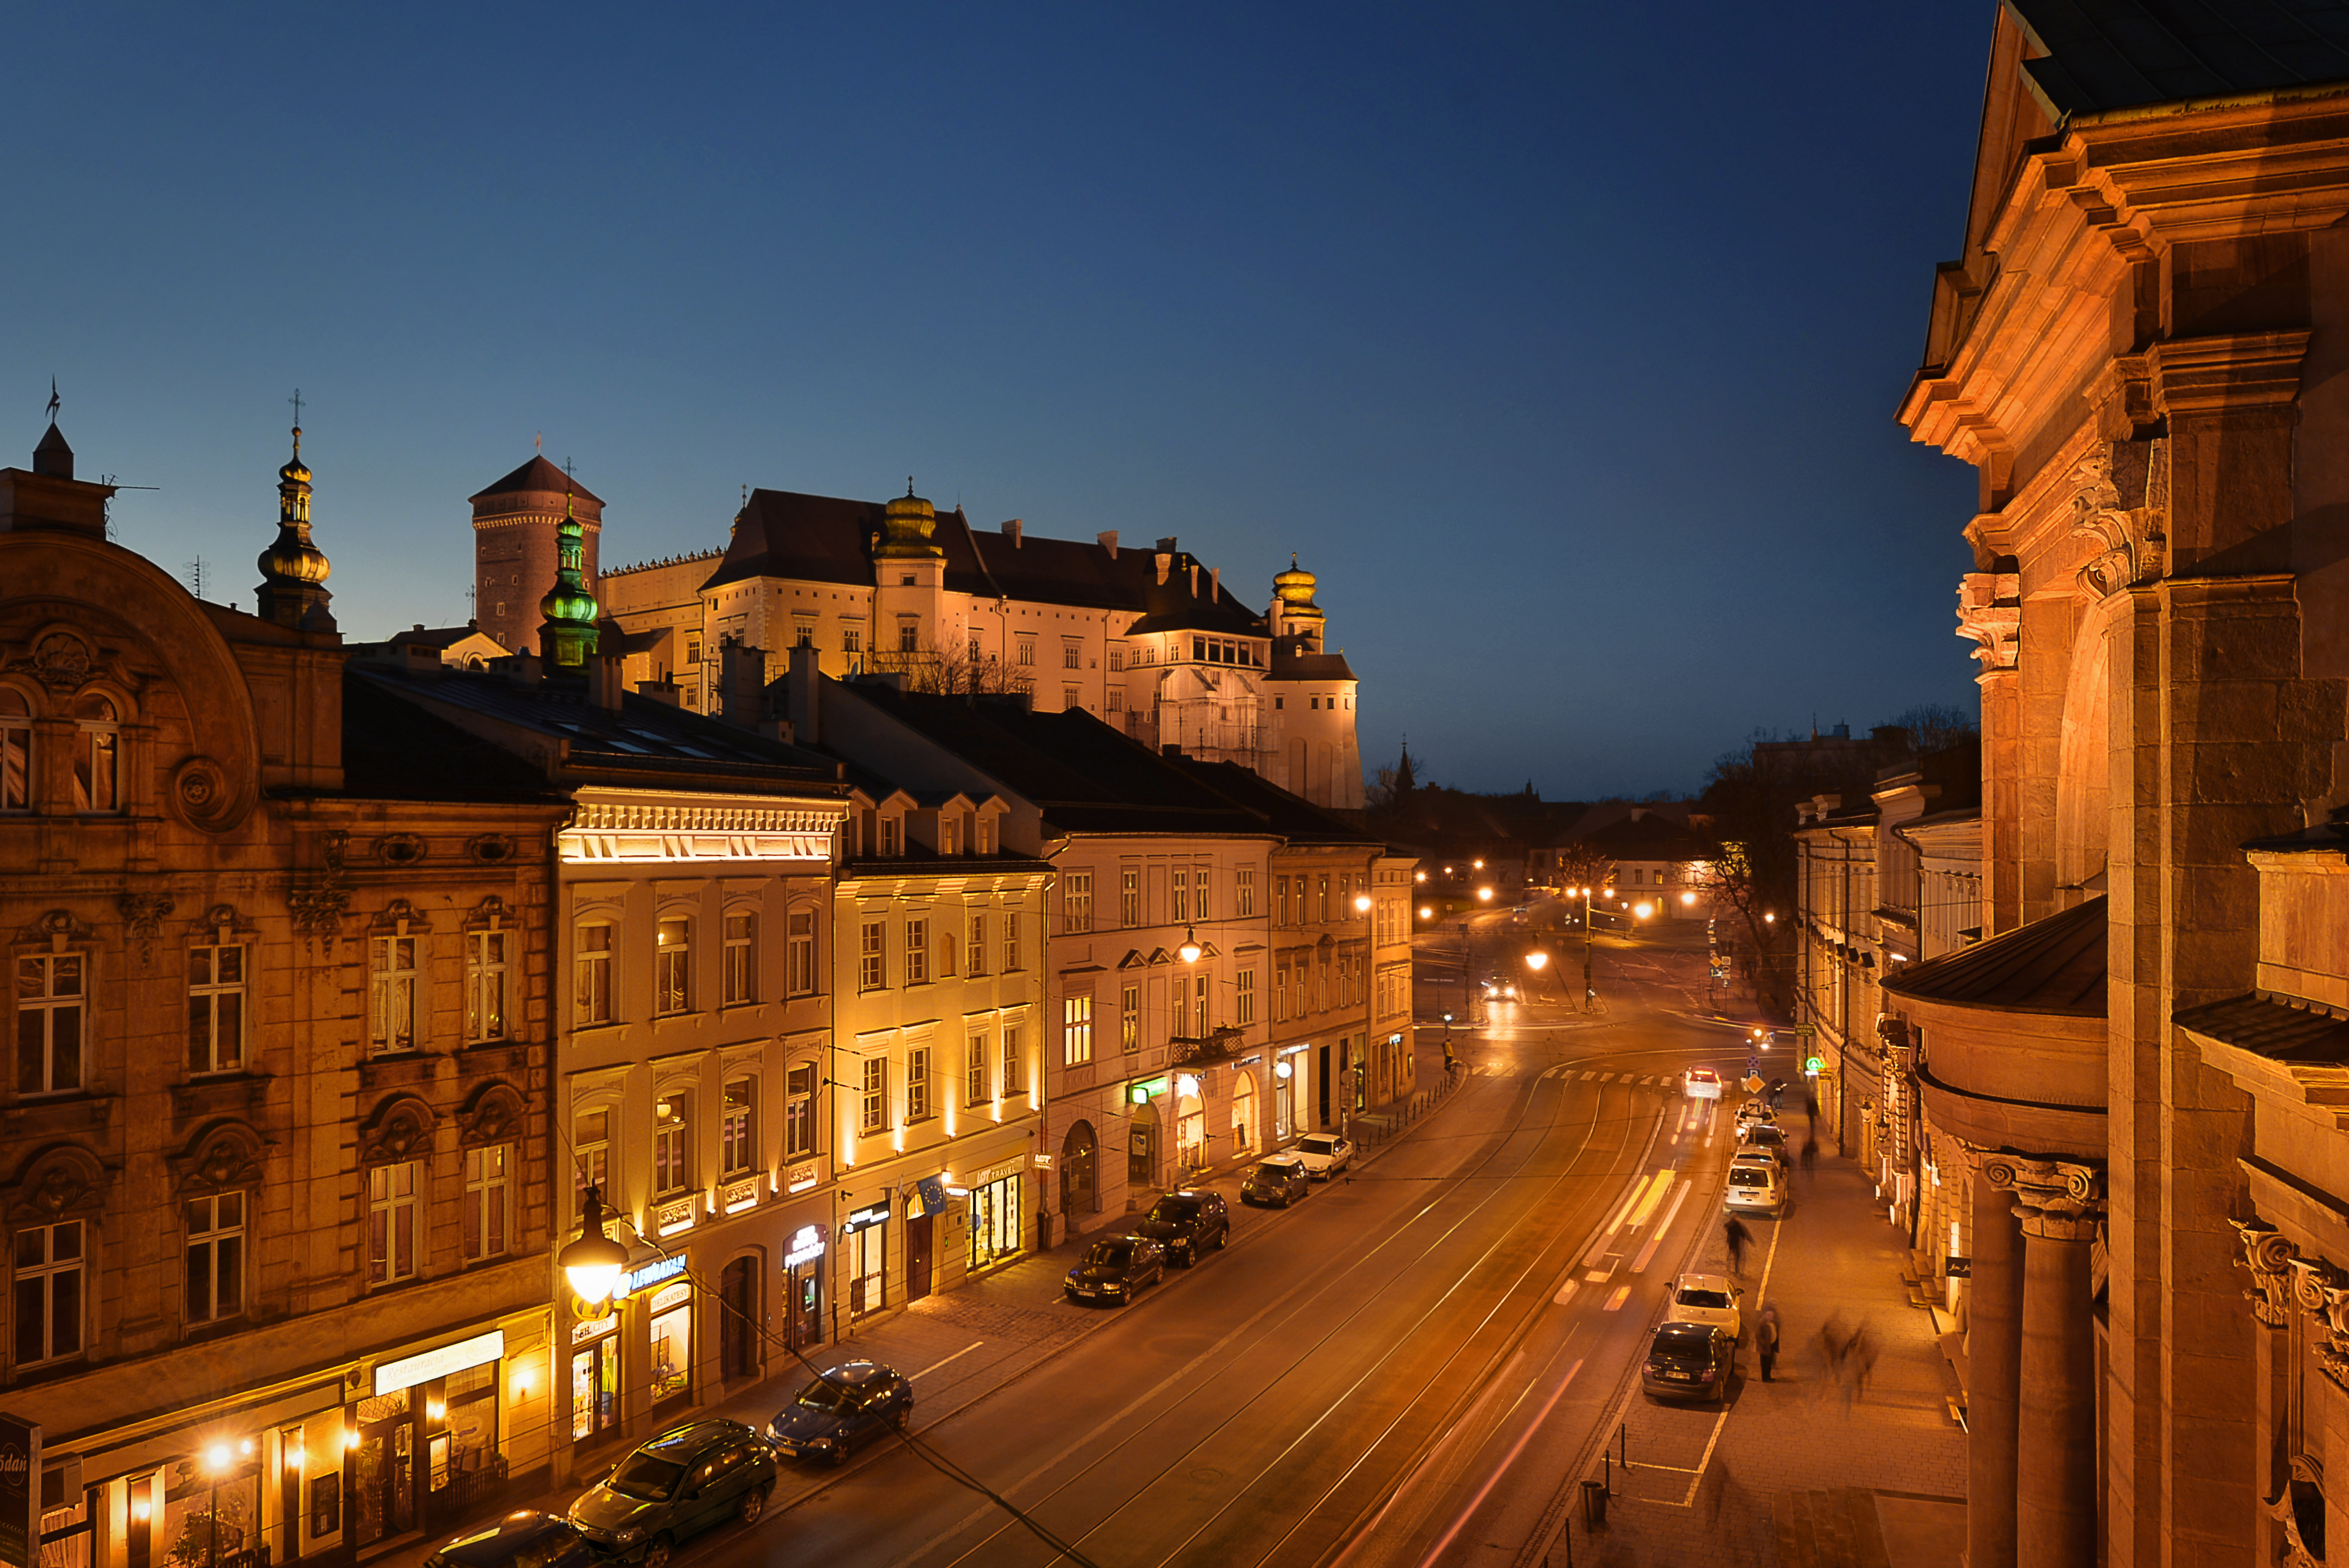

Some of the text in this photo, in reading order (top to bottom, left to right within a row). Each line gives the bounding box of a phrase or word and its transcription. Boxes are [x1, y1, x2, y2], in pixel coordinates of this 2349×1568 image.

[1035, 1154, 1052, 1163] LOT
[977, 1166, 1015, 1185] LOT TRAVEL
[652, 1288, 688, 1309] DELIKATESY
[593, 1319, 609, 1332] CITY
[386, 1354, 444, 1381] Restauracja
